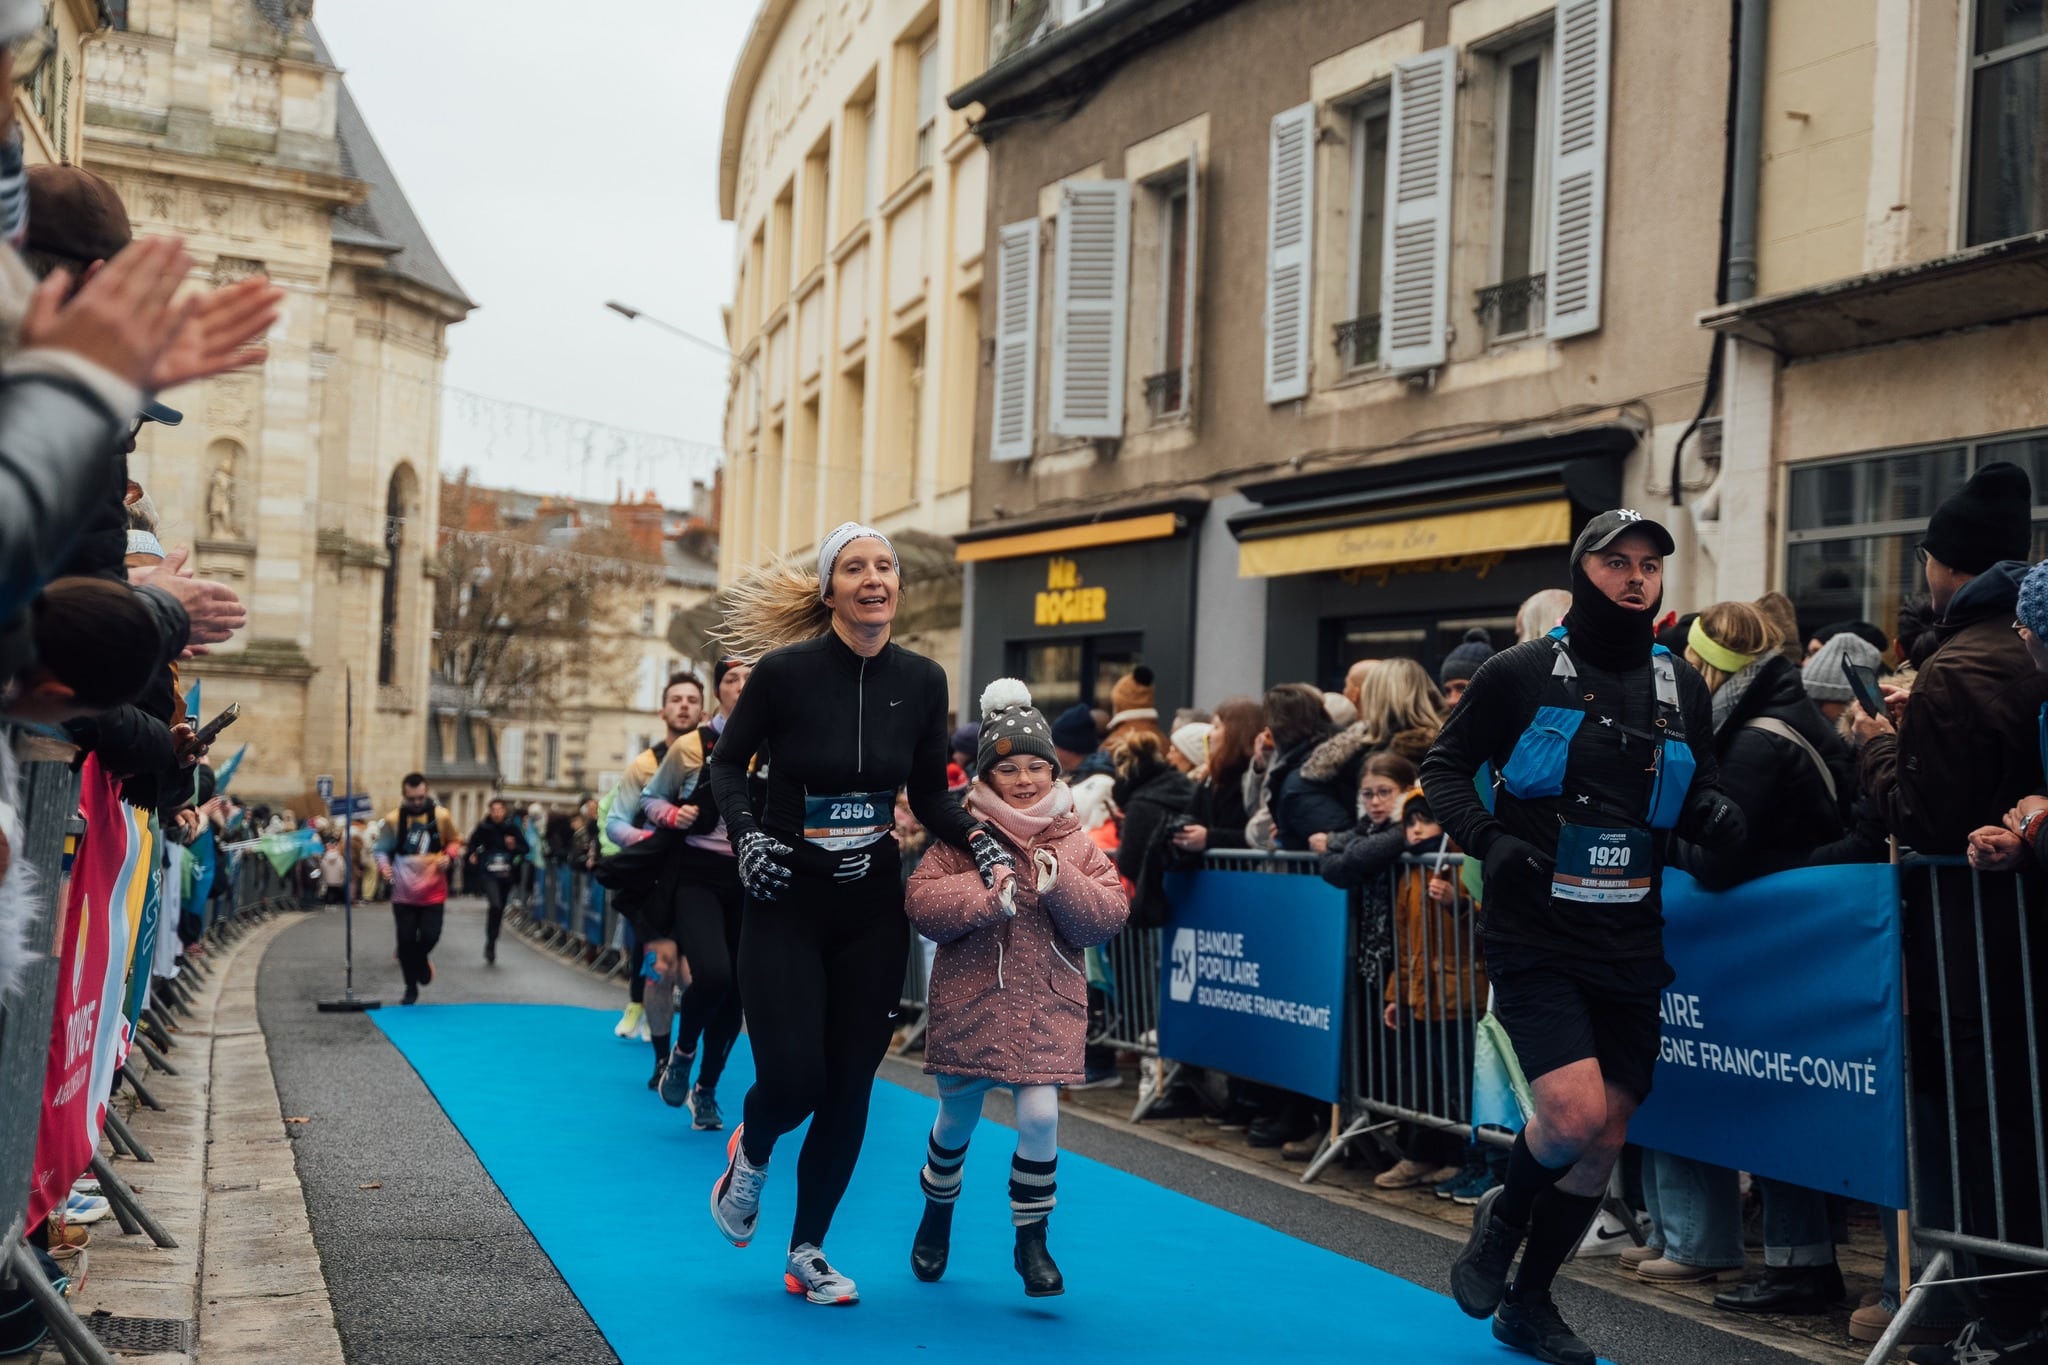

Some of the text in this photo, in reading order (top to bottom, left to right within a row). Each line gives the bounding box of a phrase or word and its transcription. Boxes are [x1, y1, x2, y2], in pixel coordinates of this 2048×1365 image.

[1035, 587, 1106, 625] ROGIER
[1588, 846, 1631, 867] 1920
[1581, 878, 1630, 889] SEMI-MARATHON
[1198, 929, 1244, 958] BANQUE
[1198, 956, 1260, 988] POPULAIRE
[1198, 986, 1331, 1031] BOURGOGNE FRANCHE-COMTÉ
[1656, 1036, 1877, 1096] GNE FRANCHE-COMTÉ
